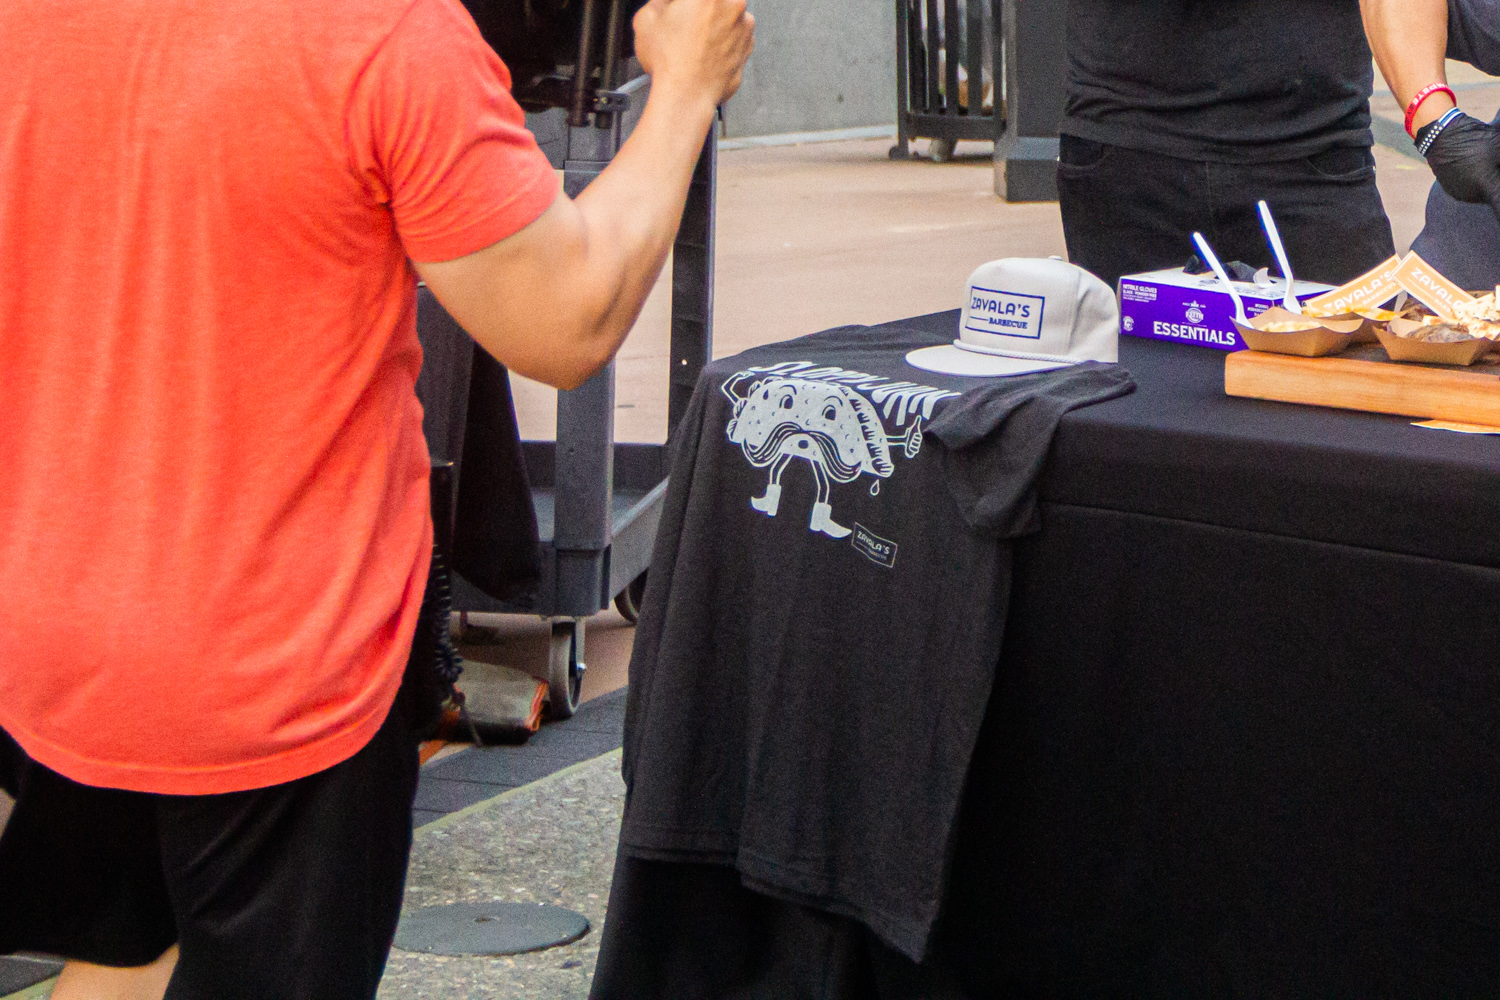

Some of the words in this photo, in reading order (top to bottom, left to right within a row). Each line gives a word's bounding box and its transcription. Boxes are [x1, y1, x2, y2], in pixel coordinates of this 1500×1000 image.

[970, 296, 1031, 319] ZAVALA'S
[988, 317, 1028, 330] BARBECUE
[1153, 320, 1236, 346] ESSENTIALS
